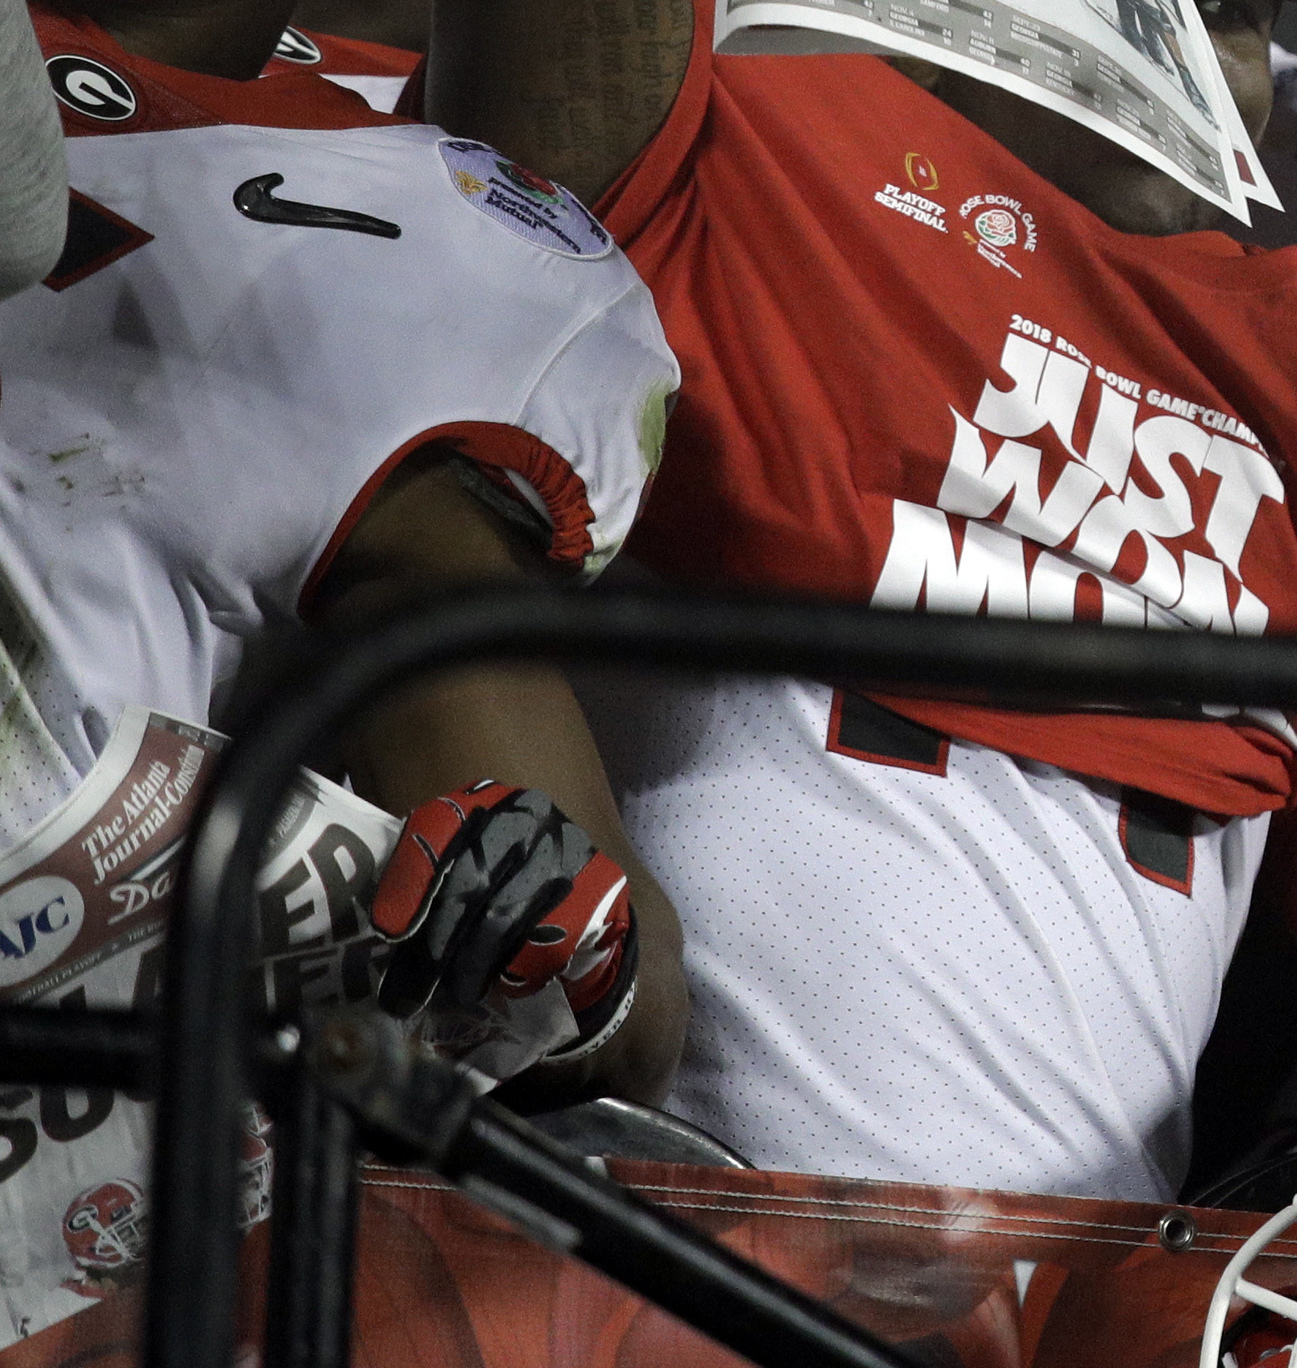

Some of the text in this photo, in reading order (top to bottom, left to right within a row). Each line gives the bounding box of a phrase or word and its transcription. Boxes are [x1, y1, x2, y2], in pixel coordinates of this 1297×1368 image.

[883, 183, 946, 217] PLAYOFF
[984, 194, 1022, 216] BOWL
[1021, 213, 1038, 252] GAME
[1009, 313, 1052, 343] 2018
[1095, 364, 1142, 399] BOWL
[1146, 389, 1199, 421] GAME
[972, 332, 1285, 585] JUST
[936, 403, 1269, 637] WON
[82, 815, 127, 862] The
